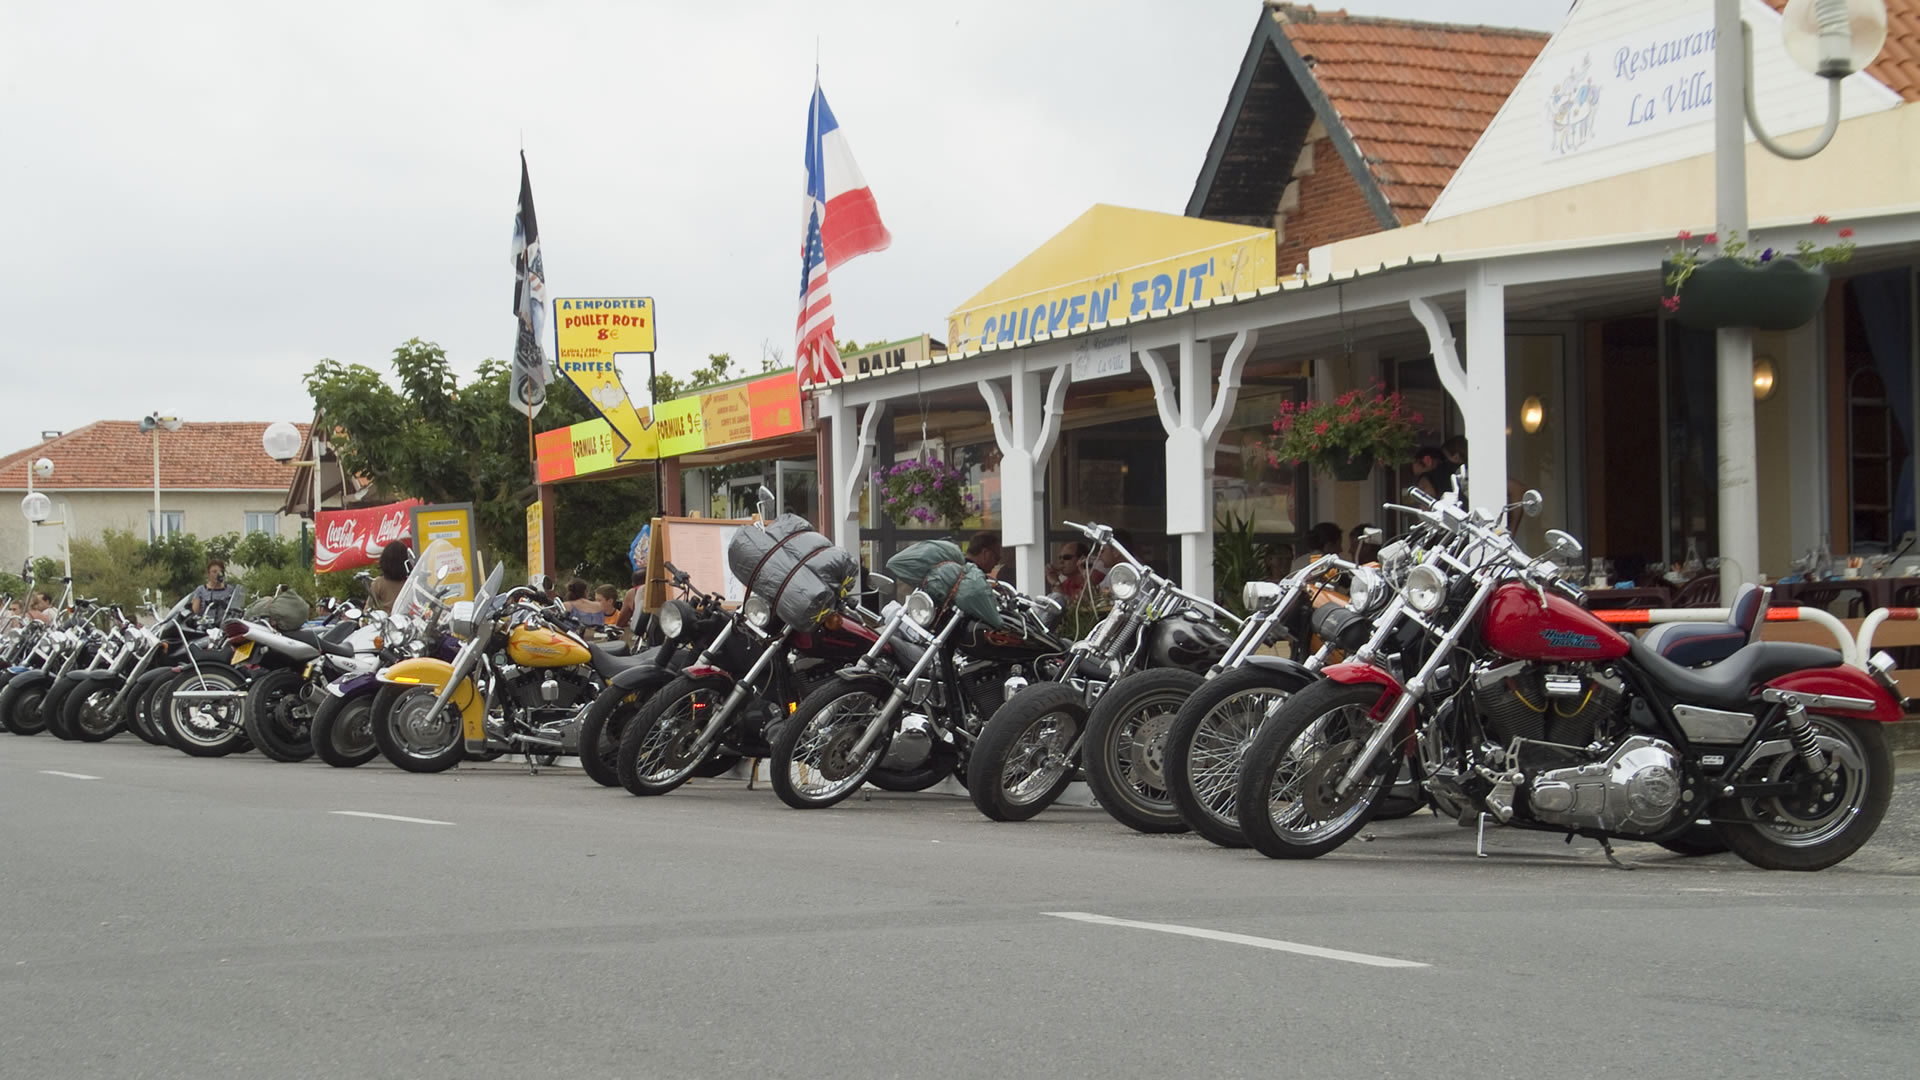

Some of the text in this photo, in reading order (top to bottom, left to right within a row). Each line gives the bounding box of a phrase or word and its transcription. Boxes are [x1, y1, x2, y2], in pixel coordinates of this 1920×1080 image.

[1614, 27, 1716, 80] Restauran
[1627, 70, 1713, 127] La Villa
[563, 299, 646, 310] A EMPORTER
[565, 313, 645, 329] POULET ROTI
[564, 361, 612, 373] FRITES
[656, 415, 686, 441] FORMULE
[572, 434, 597, 459] FORMULE
